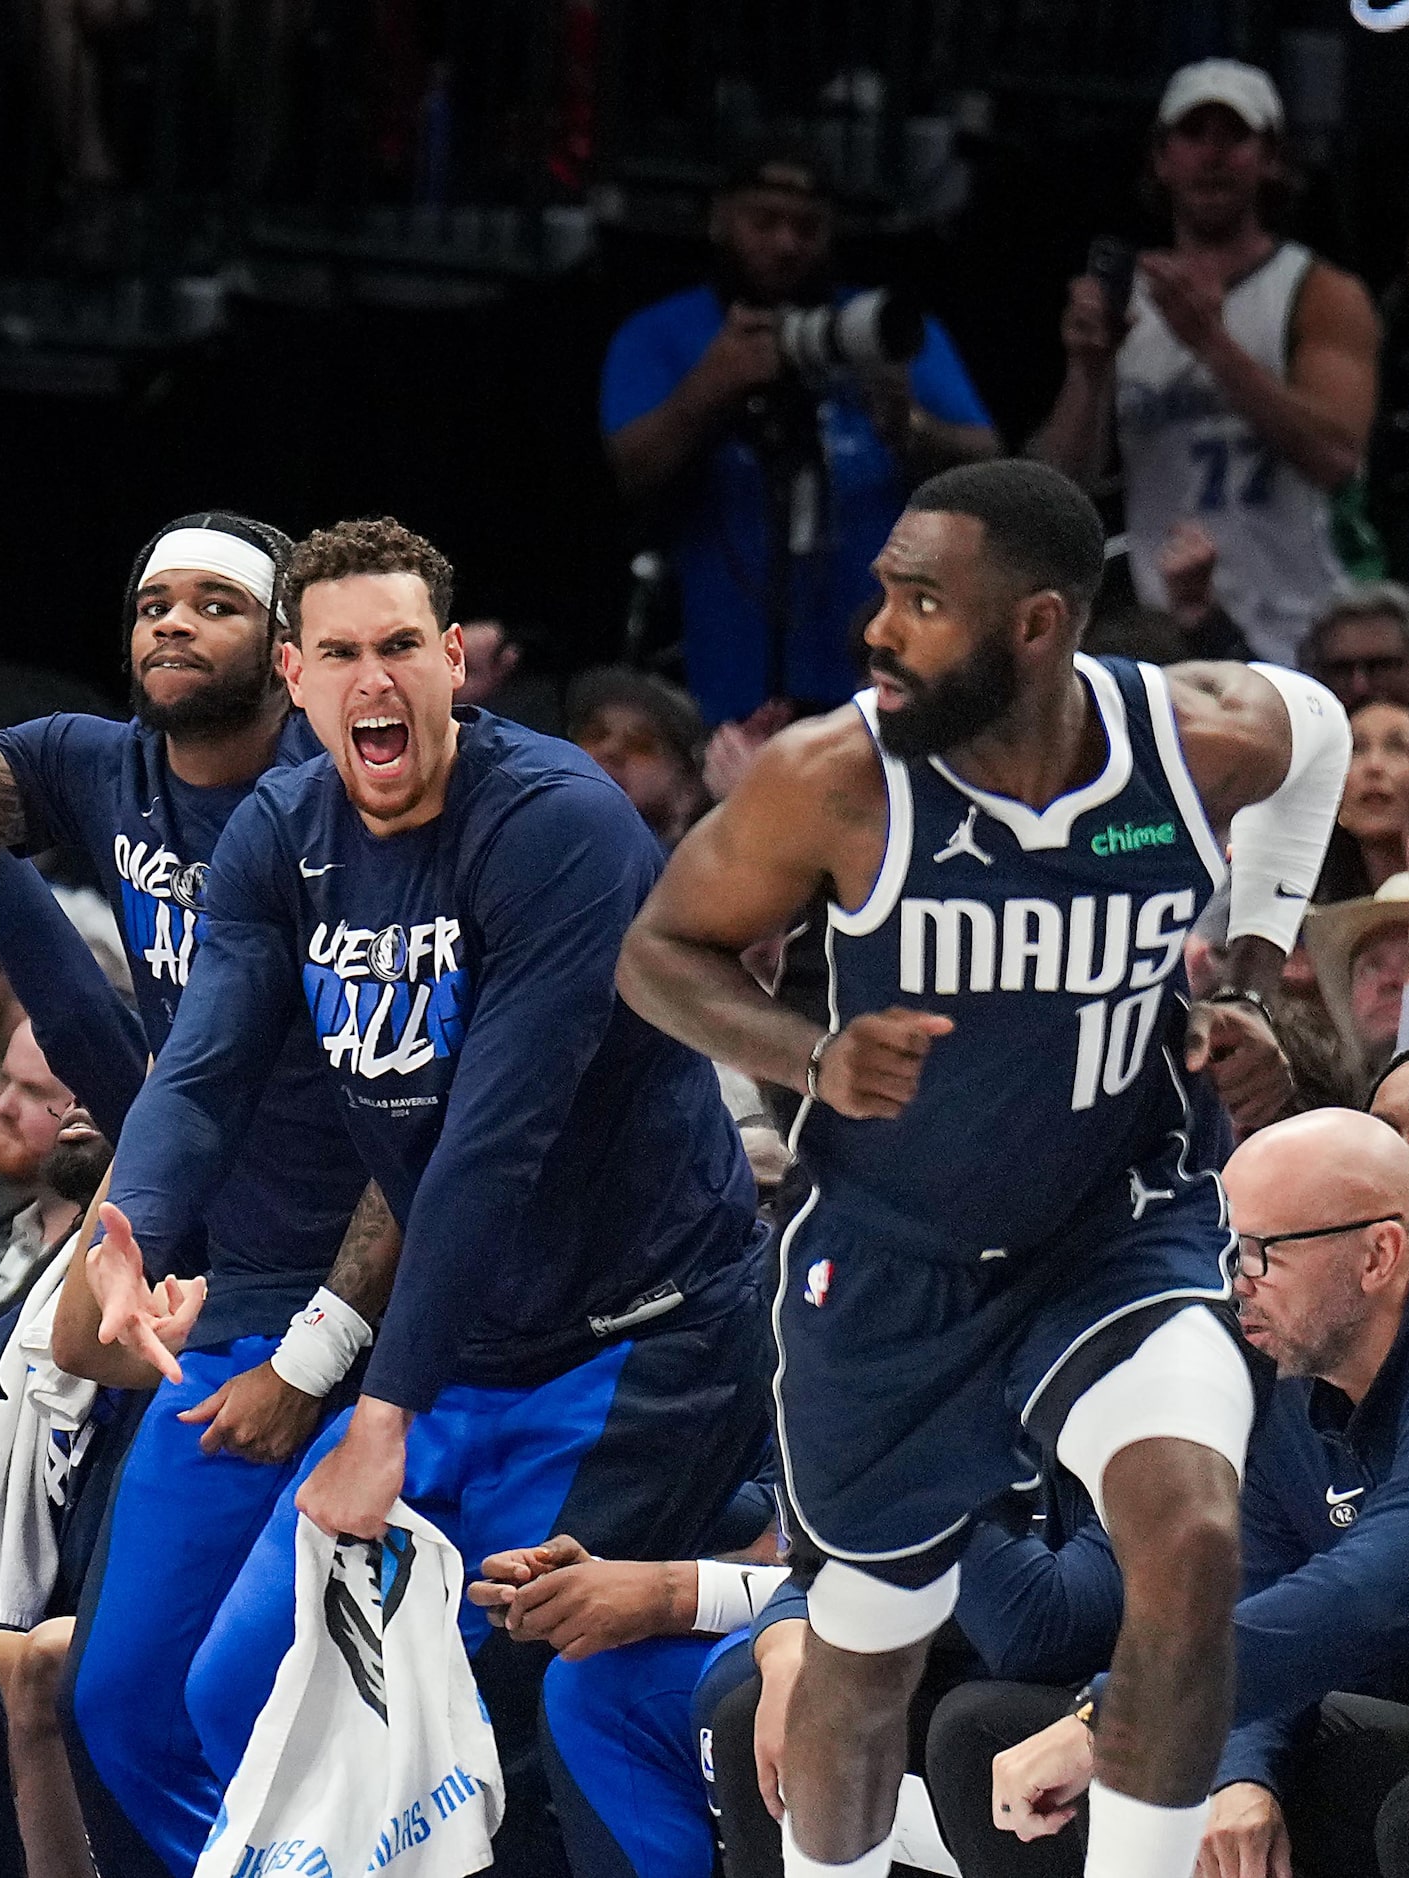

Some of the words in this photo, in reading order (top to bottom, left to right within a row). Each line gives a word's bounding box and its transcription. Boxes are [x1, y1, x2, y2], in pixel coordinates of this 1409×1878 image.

[1091, 822, 1175, 857] chime
[899, 889, 1195, 995] MAVS
[322, 981, 435, 1079] ALL
[1071, 982, 1164, 1111] 10
